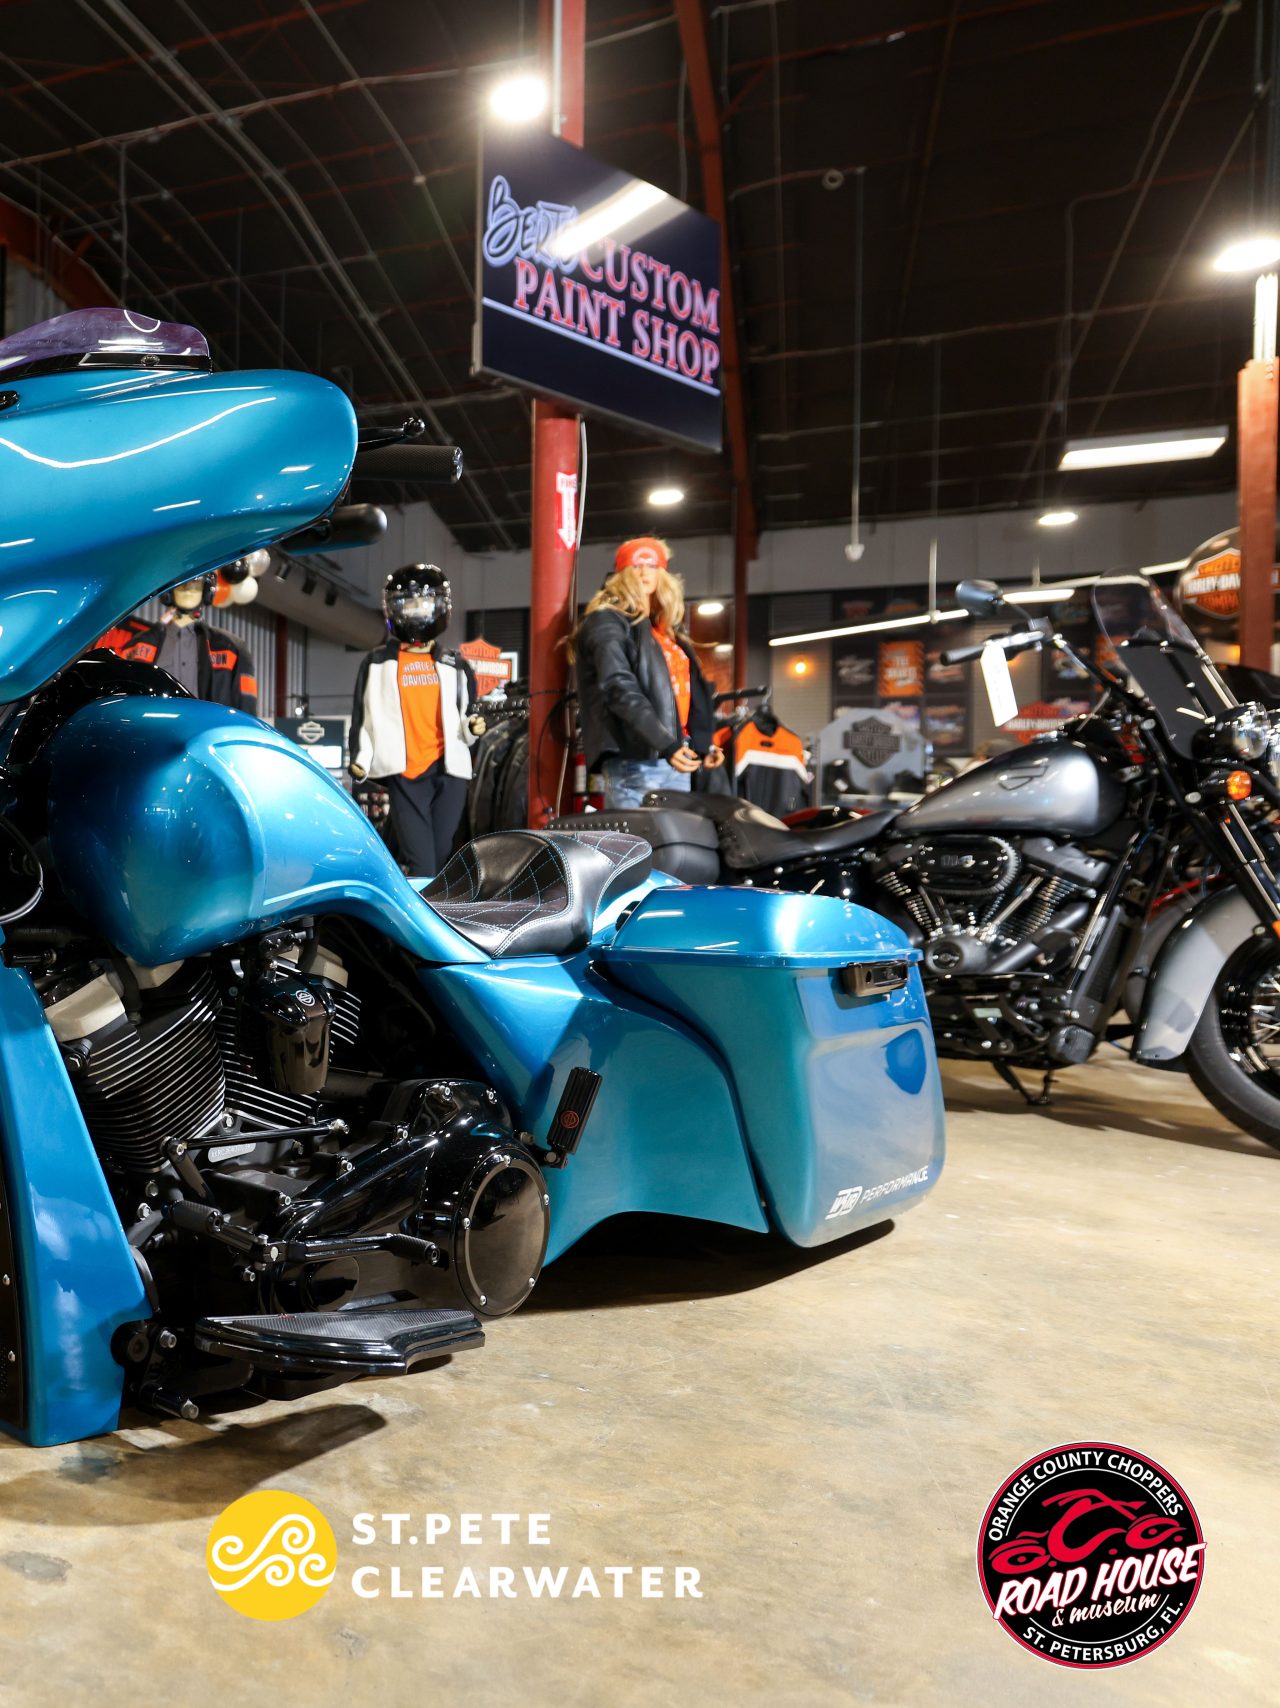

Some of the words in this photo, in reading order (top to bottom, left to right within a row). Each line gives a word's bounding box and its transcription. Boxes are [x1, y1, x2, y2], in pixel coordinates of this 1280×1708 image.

[580, 237, 721, 334] CUSTOM
[513, 257, 625, 346] PAINT
[632, 309, 721, 384] SHOP
[402, 673, 439, 687] DAVIDSO
[403, 661, 435, 672] HARLE
[861, 1165, 929, 1203] PERFORMANCE
